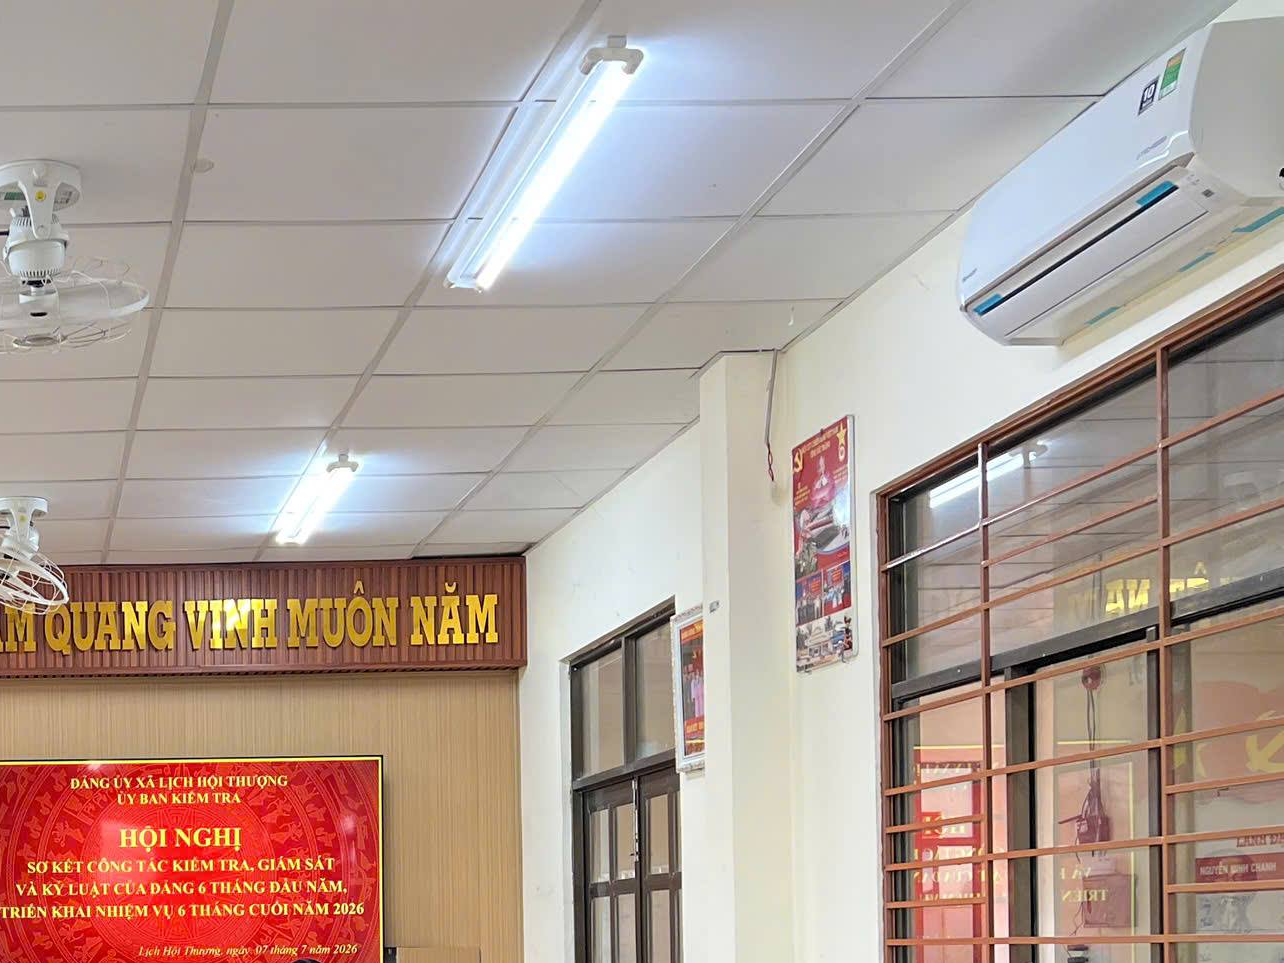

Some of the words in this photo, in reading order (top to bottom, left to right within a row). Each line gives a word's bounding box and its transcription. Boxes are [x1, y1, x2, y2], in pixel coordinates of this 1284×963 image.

[44, 600, 177, 655] QUANG
[184, 598, 278, 650] VINH
[287, 580, 399, 648] MUÔN
[410, 581, 499, 646] NĂM
[70, 775, 110, 789] ĐẢNG
[114, 774, 133, 789] ỦY
[135, 775, 155, 788] XÃ
[159, 776, 193, 791] LỊCH
[197, 774, 224, 790] HỘI
[226, 774, 288, 789] THƯỢNG
[139, 793, 168, 805] BAN
[172, 791, 209, 804] KIỂM
[213, 792, 241, 804] TRA
[119, 825, 167, 852] HỘI
[175, 827, 242, 852] NGHỊ
[27, 860, 49, 874] SƠ
[52, 859, 84, 873] KẾT
[87, 857, 132, 873] CÔNG
[136, 859, 169, 872] TÁC
[173, 857, 214, 872] KIỂM
[218, 858, 255, 872] TRA,
[257, 856, 301, 871] GIÁM
[304, 855, 335, 871] SÁT
[16, 881, 38, 896] VÀ
[68, 882, 111, 898] LUẬT
[114, 880, 147, 895] CỦA
[150, 880, 194, 895] ĐẢNG
[198, 881, 207, 894] 6
[209, 878, 266, 894] THÁNG
[306, 878, 348, 894] NĂM,
[0, 903, 48, 919] TRIỂN
[52, 905, 92, 918] KHAI
[95, 904, 149, 920] NHIỆM
[152, 905, 175, 919] VỤ
[178, 904, 186, 917] 6
[190, 901, 245, 917] THÁNG
[249, 900, 289, 916] CUỐI
[293, 900, 329, 915] NĂM
[333, 902, 365, 915] 2026
[139, 946, 160, 957] Lịch
[254, 944, 268, 954] 07
[270, 944, 298, 956] tháng
[301, 944, 308, 954] 7
[310, 944, 331, 954] năm
[333, 944, 359, 954] 2026
